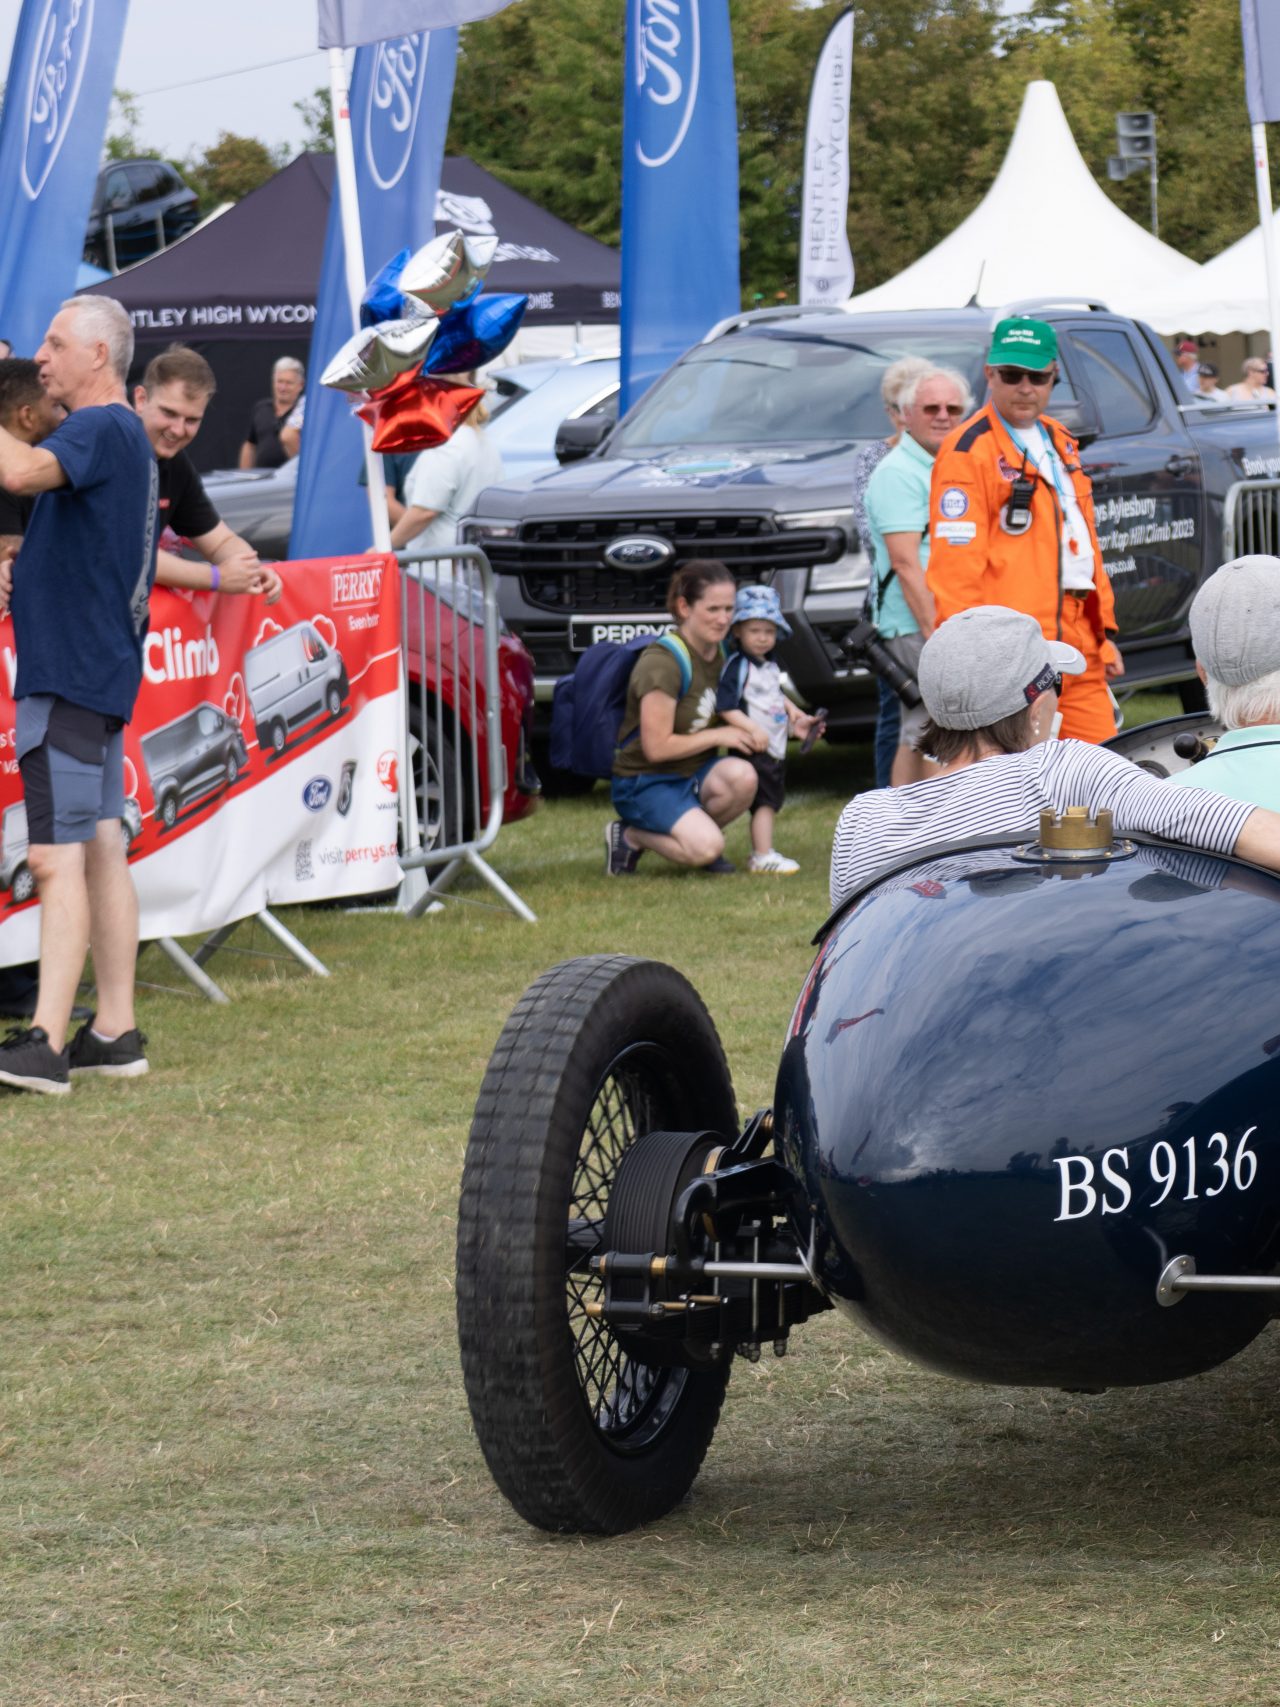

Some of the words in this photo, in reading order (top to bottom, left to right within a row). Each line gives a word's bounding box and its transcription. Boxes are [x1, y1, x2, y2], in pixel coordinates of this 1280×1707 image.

[810, 137, 827, 262] BENTLEY
[129, 307, 187, 328] NTLEY
[191, 305, 242, 326] HIGH
[245, 303, 318, 324] WYCO
[527, 292, 555, 310] OMBE
[1109, 494, 1157, 524] Aylesbury
[1111, 528, 1129, 552] Kop
[1130, 525, 1145, 546] Hill
[1145, 522, 1171, 545] Climb
[1171, 517, 1195, 540] 2023
[143, 623, 220, 685] Climb
[1052, 1147, 1132, 1222] BS
[1149, 1126, 1258, 1208] 9136
